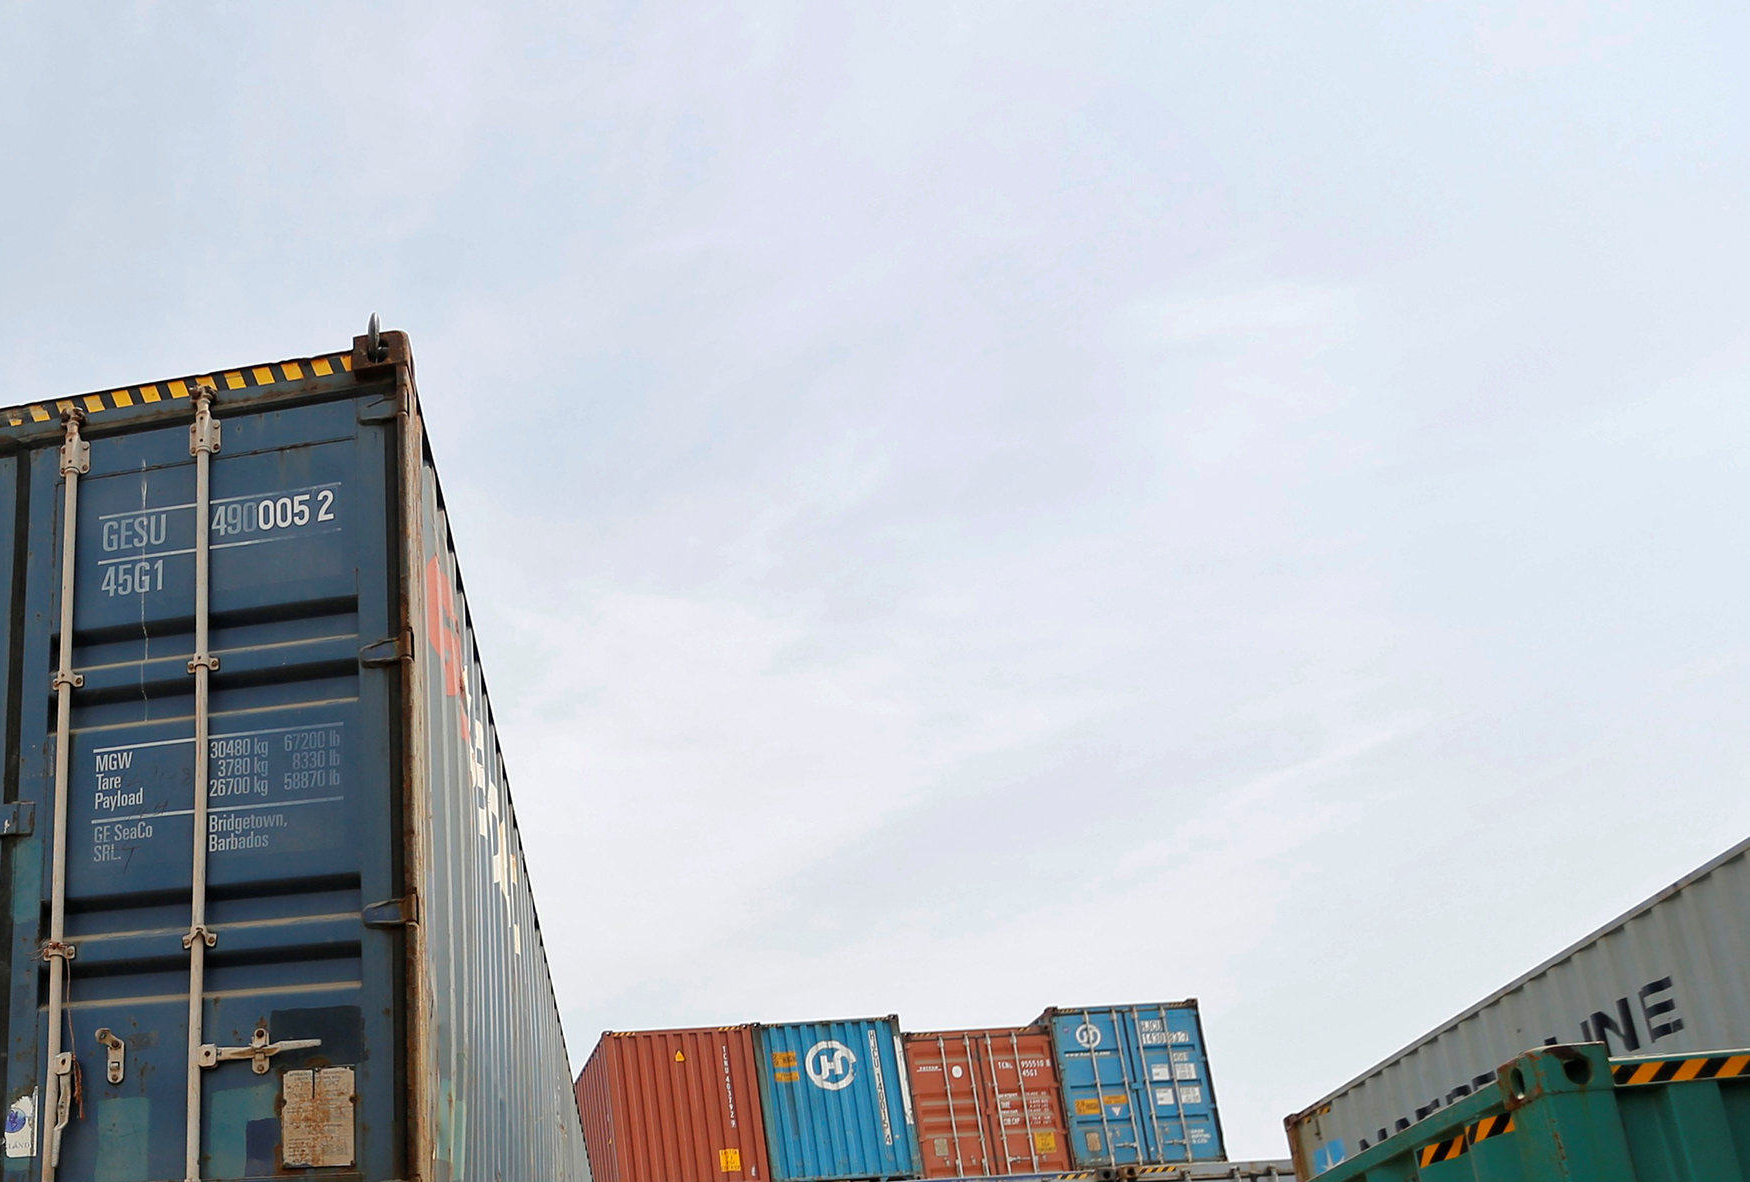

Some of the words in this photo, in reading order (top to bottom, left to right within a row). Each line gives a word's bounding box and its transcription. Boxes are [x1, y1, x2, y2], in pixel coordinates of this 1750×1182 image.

[102, 514, 167, 552] GESU
[211, 494, 310, 535] 490005
[317, 489, 334, 522] 2
[101, 560, 164, 596] 45G1
[210, 739, 250, 758] 30480
[253, 738, 269, 758] kg
[284, 732, 325, 752] 67200
[329, 730, 340, 746] lb
[95, 751, 133, 772] MGW
[217, 758, 250, 777] 3780
[253, 756, 269, 777] kg
[292, 751, 325, 770] 8330
[329, 750, 340, 766] lb
[95, 773, 121, 790] Tare
[209, 777, 250, 798] 26700
[253, 775, 269, 796] kg
[284, 771, 325, 790] 58870
[329, 769, 340, 786] lb
[94, 787, 143, 811] Payload
[93, 825, 111, 842] GE
[114, 822, 153, 842] SeaCo
[208, 811, 288, 833] Bridgetown,
[208, 832, 269, 852] Barbados
[1545, 976, 1684, 1052] INE
